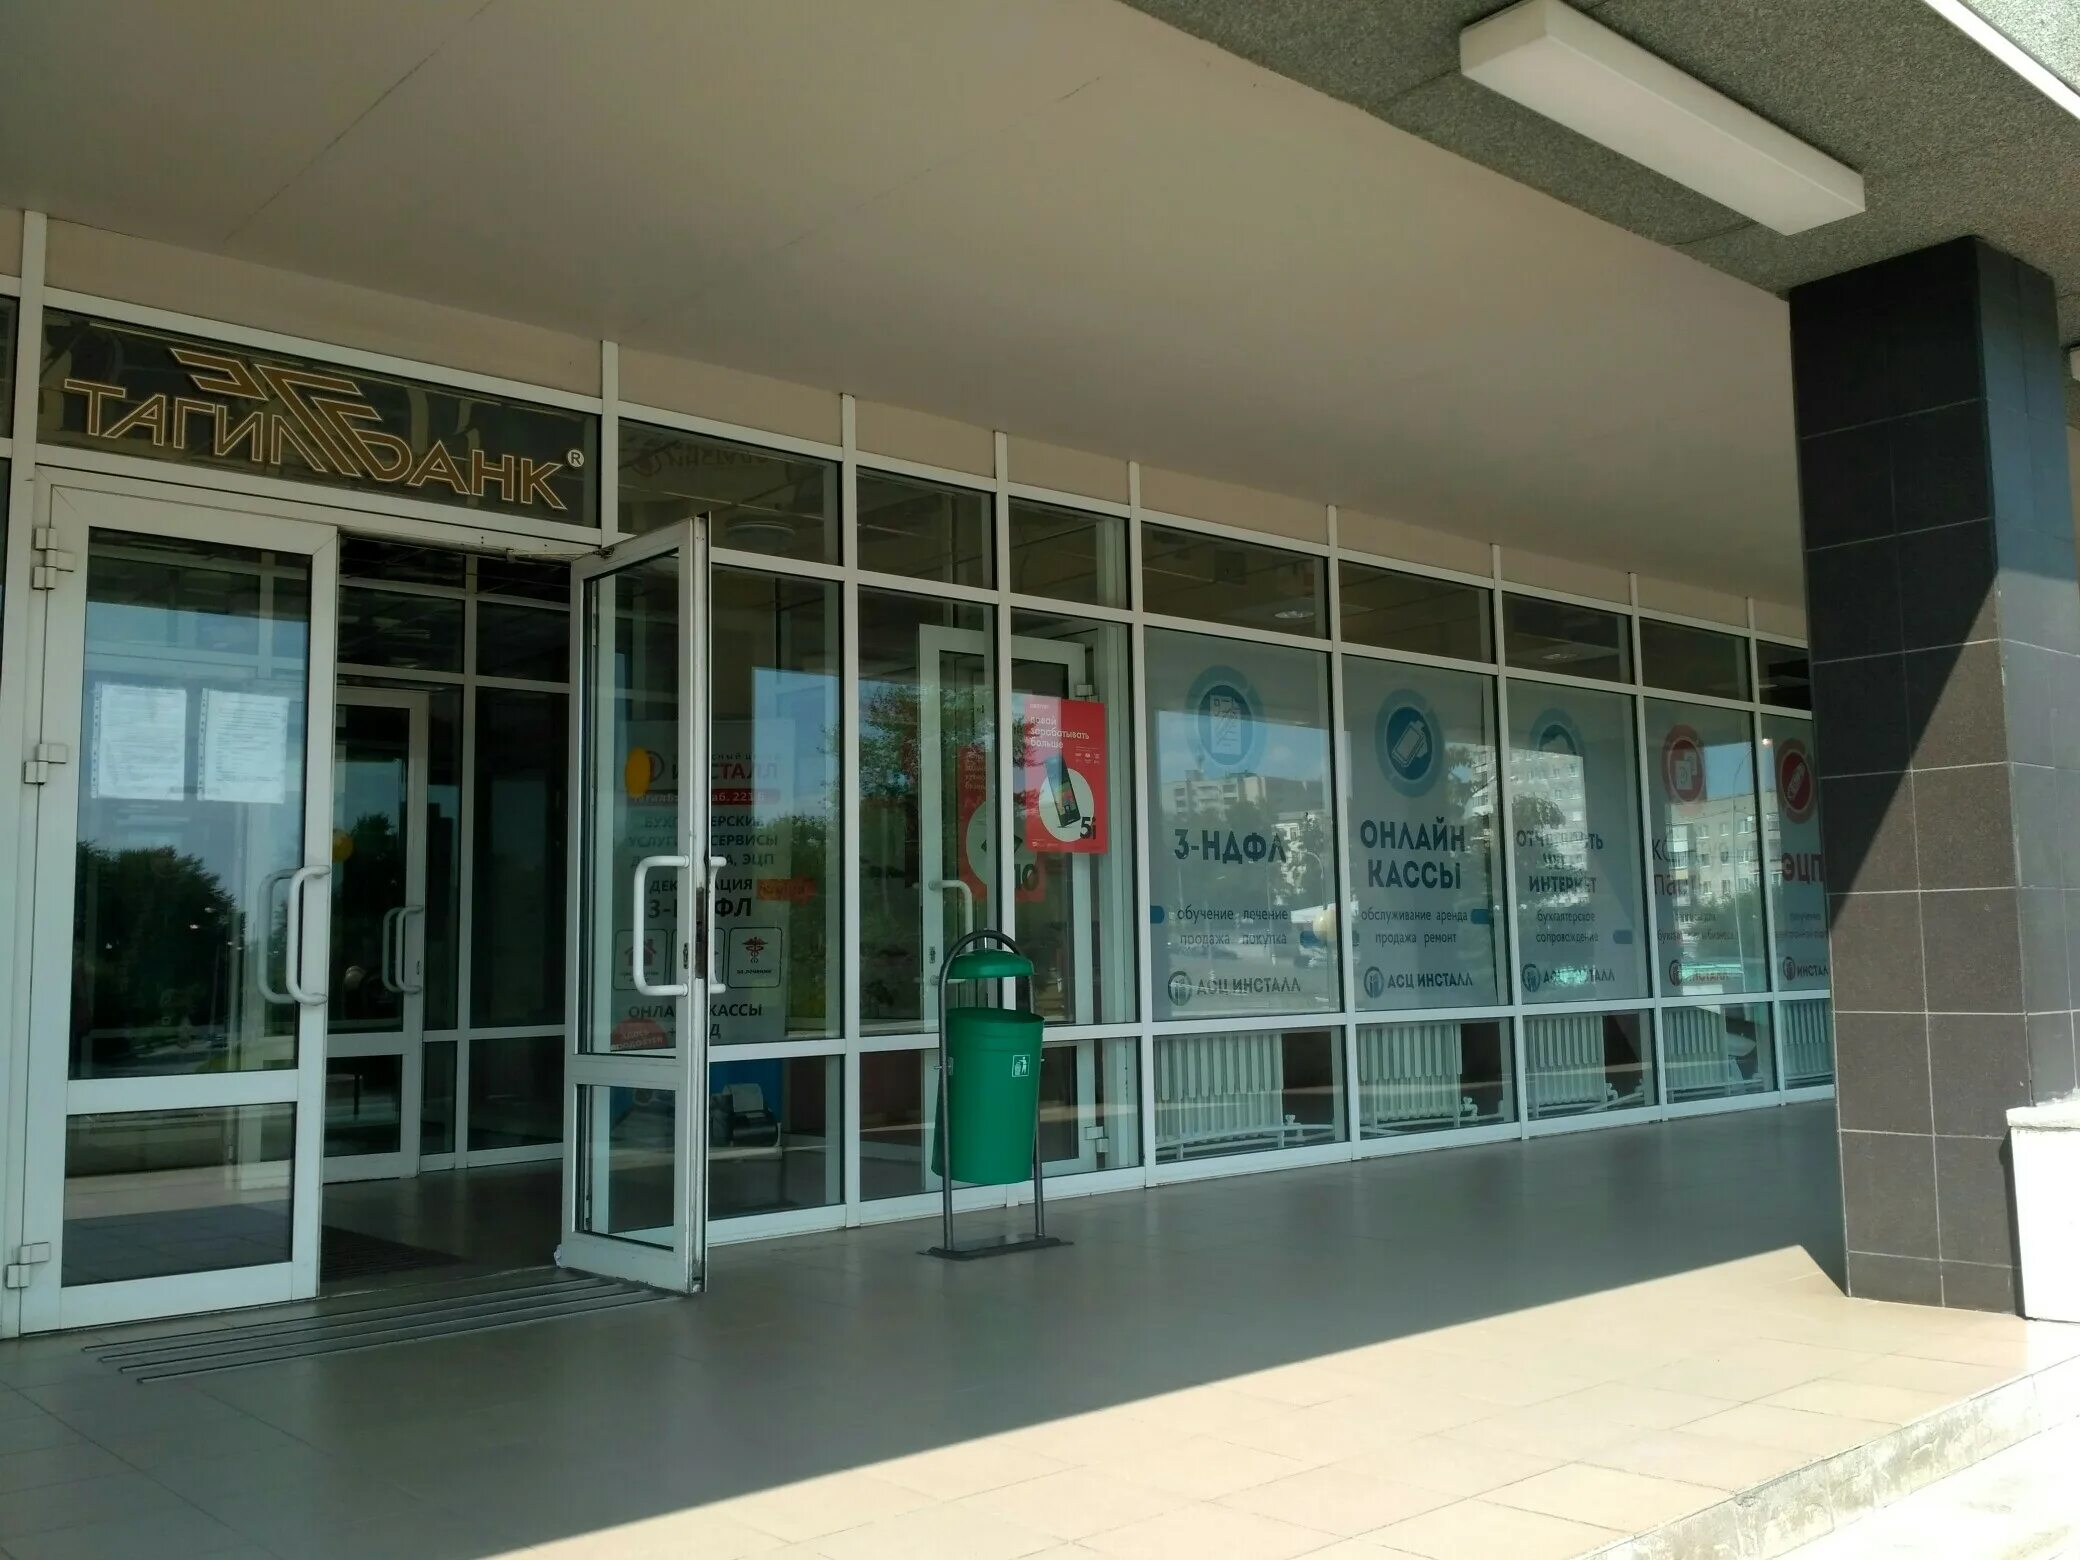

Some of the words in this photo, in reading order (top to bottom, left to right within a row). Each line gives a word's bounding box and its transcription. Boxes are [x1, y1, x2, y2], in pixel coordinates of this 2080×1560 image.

[1030, 728, 1090, 740] зарабатывать
[1030, 737, 1064, 749] больше
[1360, 817, 1467, 852] ОНЛАЙН
[1174, 829, 1288, 864] 3-НДФЛ
[743, 854, 774, 867] ЭЦП
[1368, 859, 1462, 890] КАССЫ
[1177, 905, 1235, 924] обучение
[1243, 911, 1289, 921] лечение
[1361, 906, 1432, 924] обслуживание
[1436, 911, 1468, 924] аренда
[1536, 909, 1596, 925] бухгалтерское
[1180, 933, 1231, 945] продажа
[1375, 932, 1417, 947] продажа
[1424, 932, 1458, 947] ремонт
[1535, 932, 1599, 946] сопровождение
[1197, 978, 1229, 996] АСЦ
[1232, 977, 1302, 993] ИНСТАЛЛ
[1387, 974, 1415, 990] АСЦ
[1418, 972, 1474, 988] ИНСТАЛЛ
